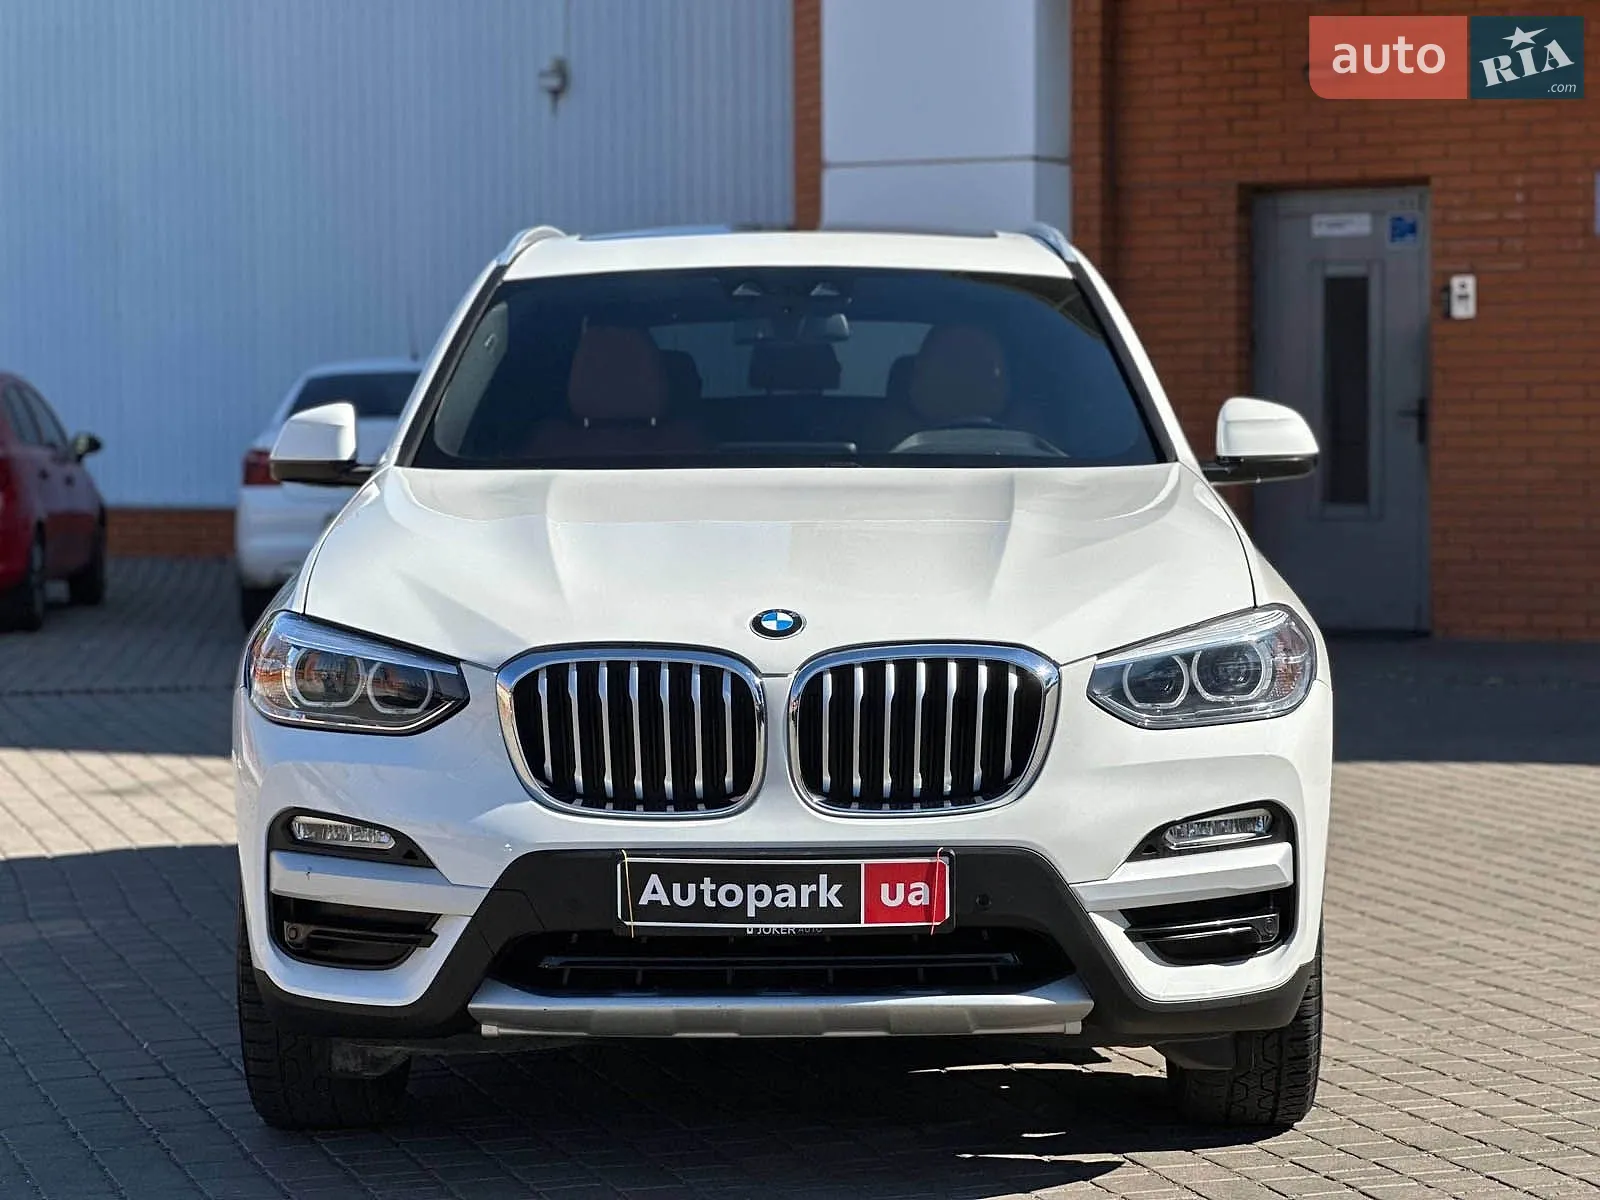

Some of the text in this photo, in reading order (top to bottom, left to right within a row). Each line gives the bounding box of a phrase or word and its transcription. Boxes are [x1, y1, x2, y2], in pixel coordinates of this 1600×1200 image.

[638, 873, 930, 917] Autopark ua
[757, 927, 796, 935] JOKER
